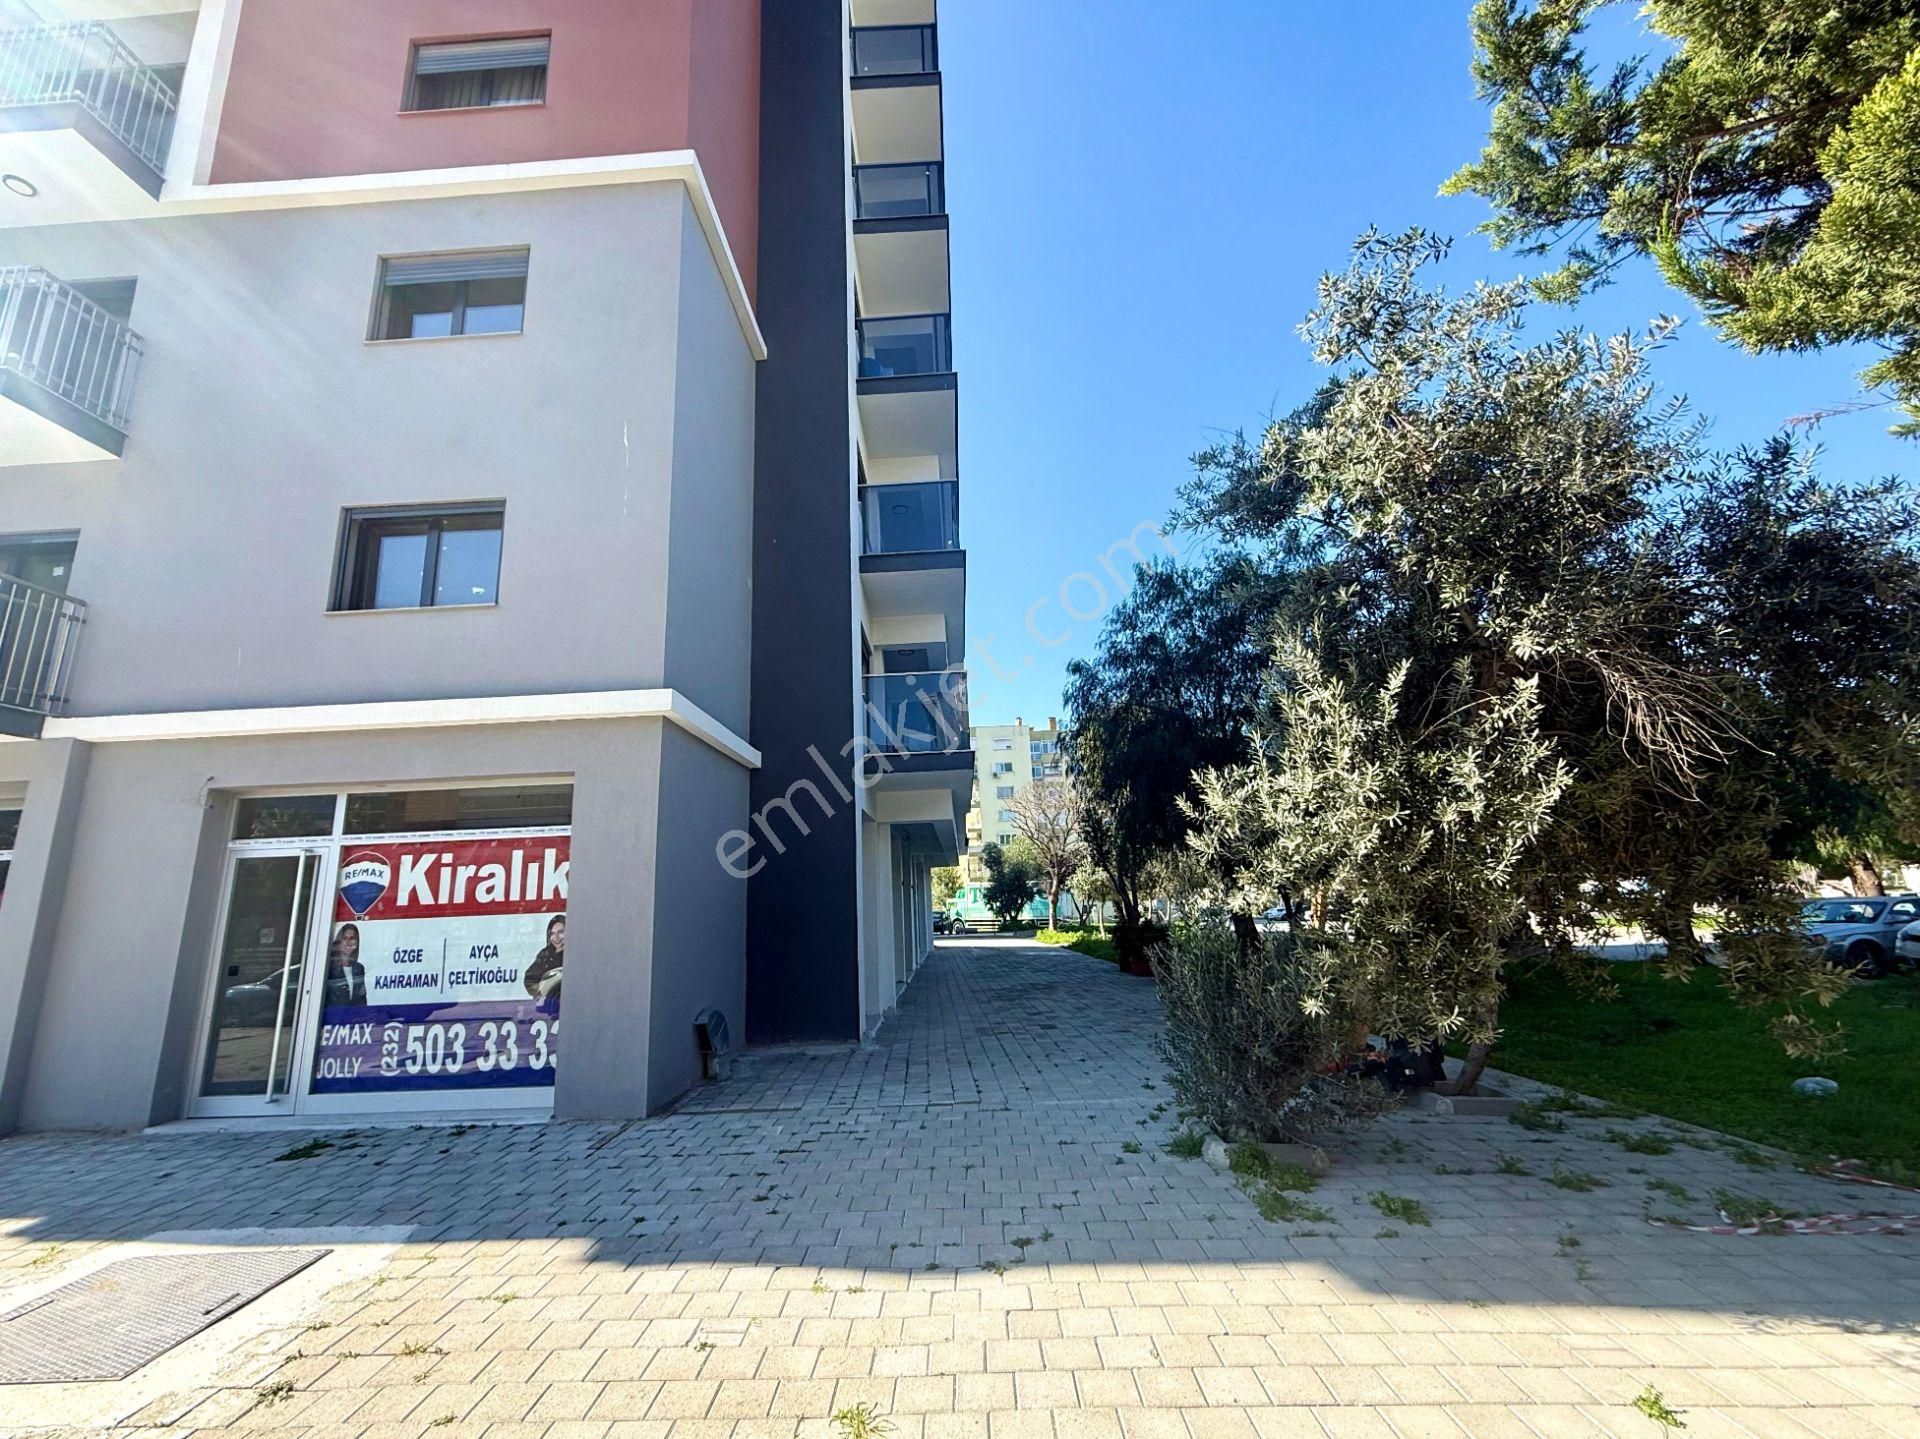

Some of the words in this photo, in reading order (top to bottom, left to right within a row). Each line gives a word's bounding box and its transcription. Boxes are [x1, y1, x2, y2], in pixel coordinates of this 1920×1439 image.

[344, 868, 384, 880] RE/MAX
[396, 848, 570, 906] Kiralık
[393, 947, 423, 963] ÖZGE
[469, 944, 499, 962] AYÇA
[374, 973, 439, 990] KAHRAMAN
[449, 965, 518, 987] ÇELTİKOĞLU
[380, 1021, 404, 1077] (232)
[405, 1023, 467, 1074] 503
[475, 1020, 519, 1071] 33
[316, 1056, 363, 1079] JOLLY
